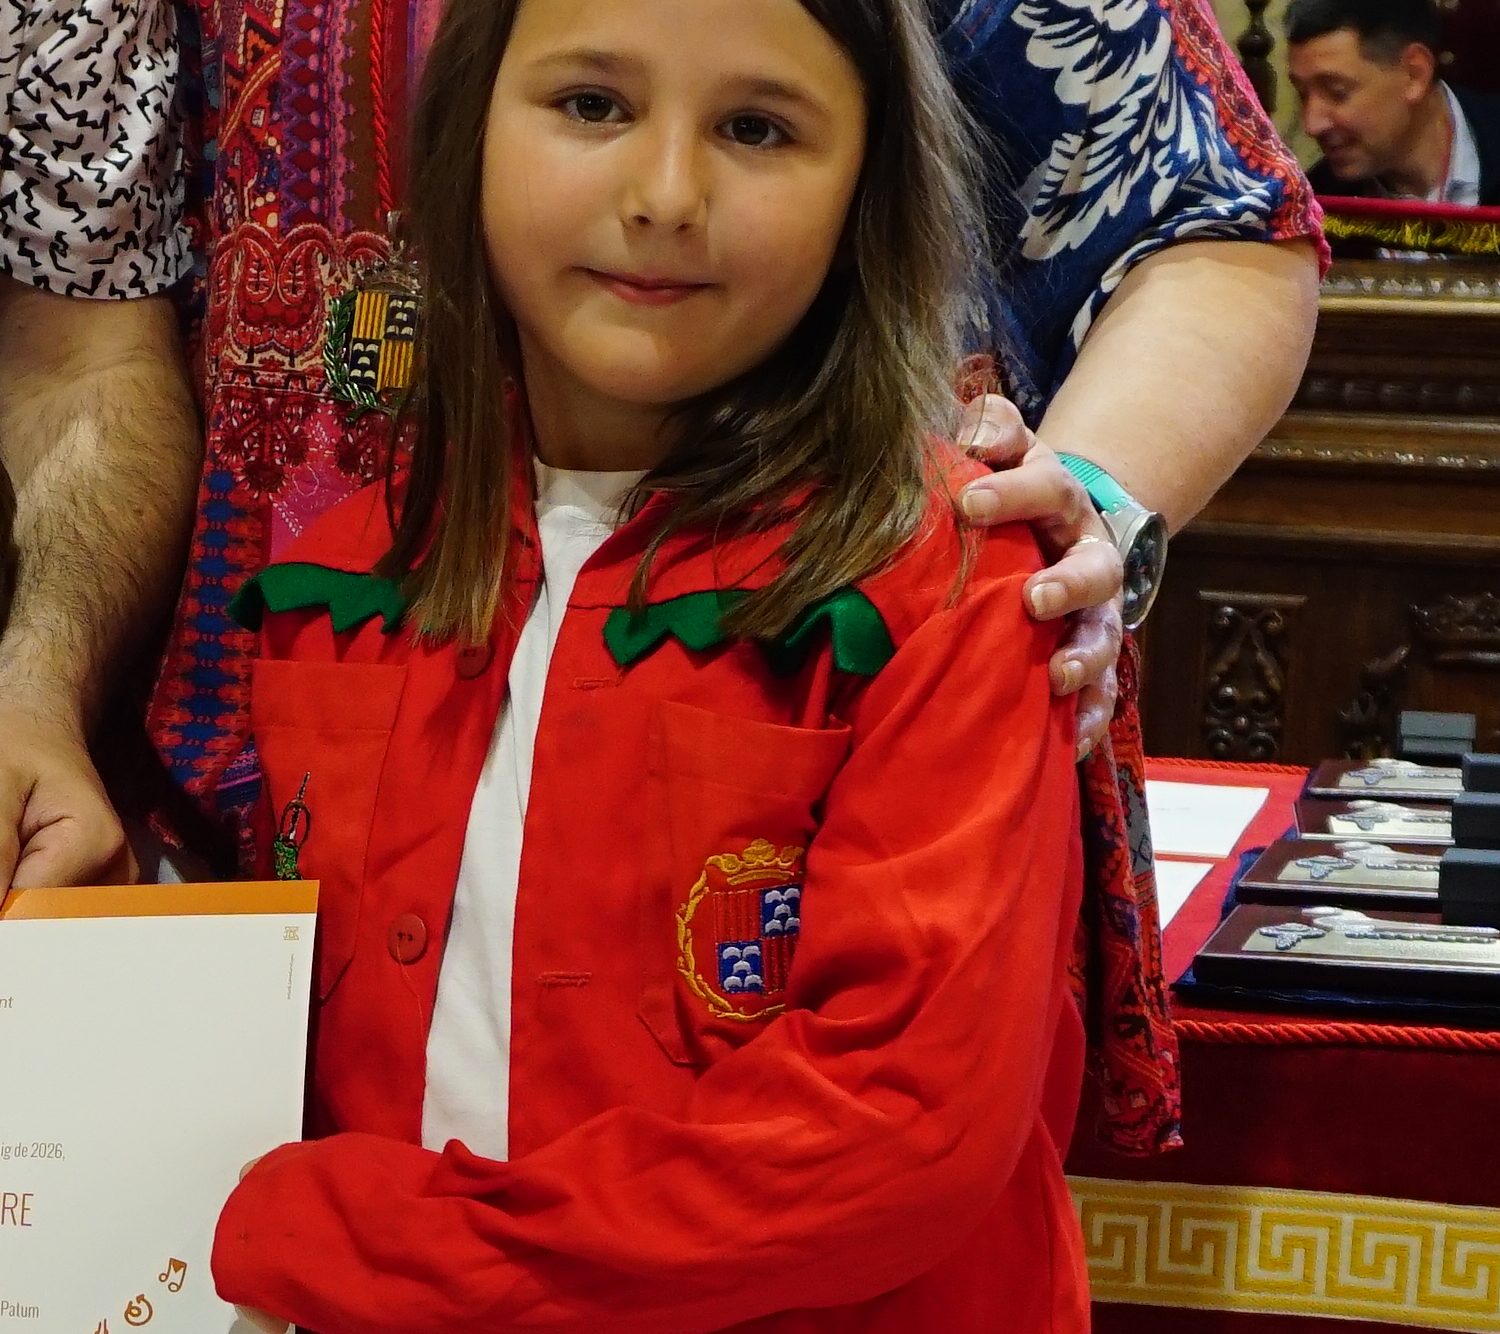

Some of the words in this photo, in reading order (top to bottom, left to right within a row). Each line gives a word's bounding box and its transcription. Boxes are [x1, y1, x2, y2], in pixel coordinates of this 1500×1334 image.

[14, 1142, 28, 1158] de
[30, 1142, 66, 1161] 2026,
[0, 1300, 39, 1318] Patum
